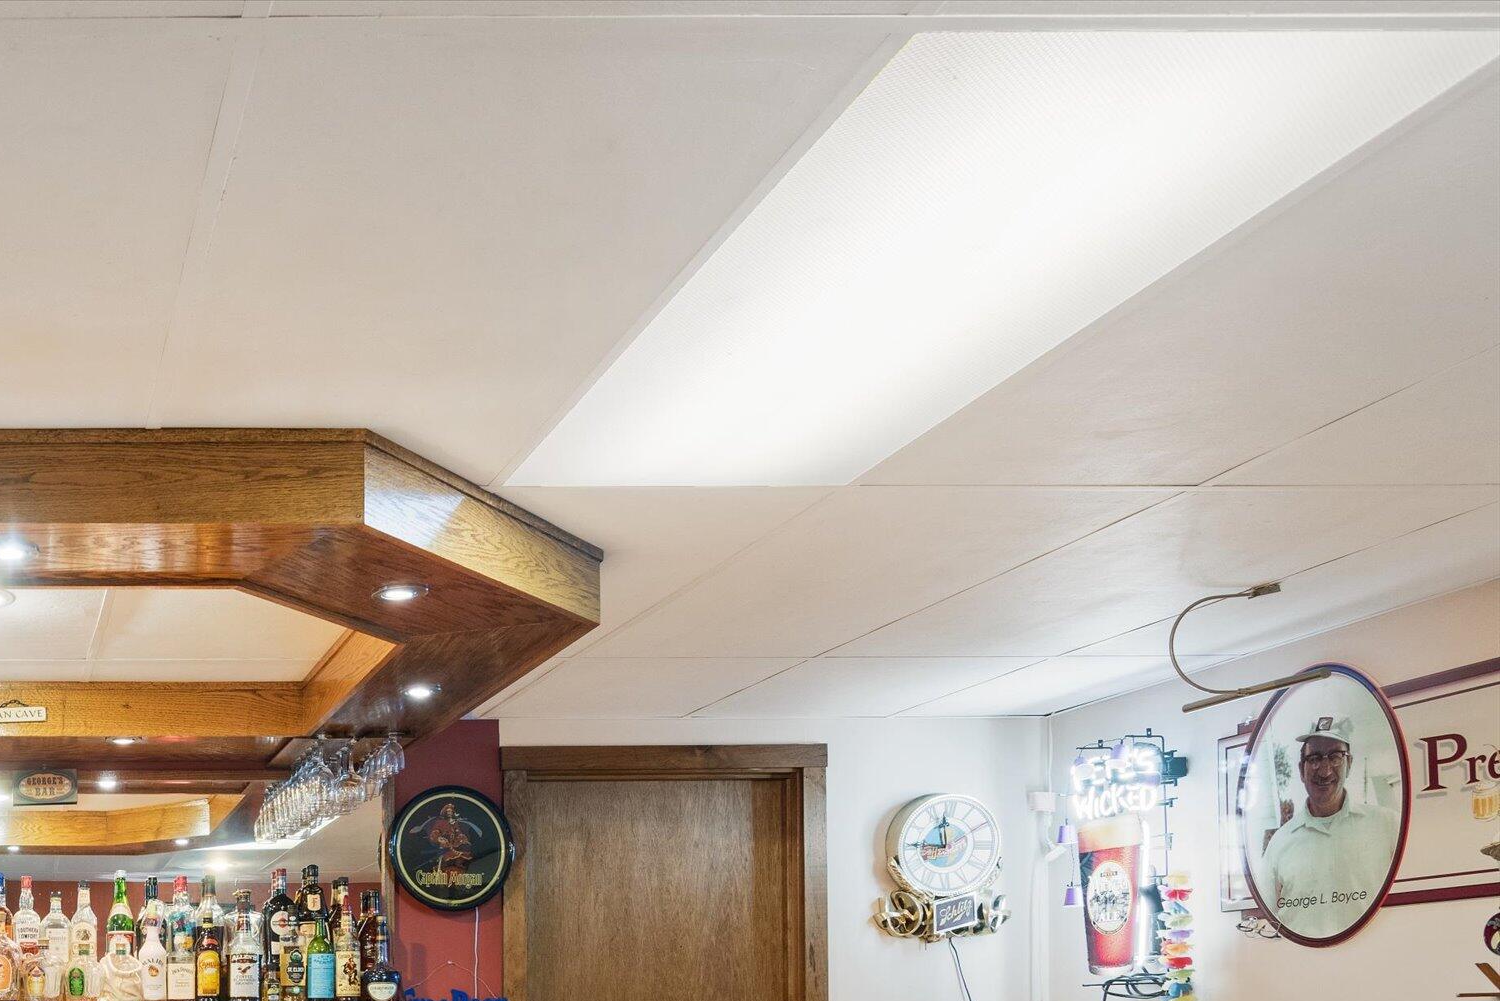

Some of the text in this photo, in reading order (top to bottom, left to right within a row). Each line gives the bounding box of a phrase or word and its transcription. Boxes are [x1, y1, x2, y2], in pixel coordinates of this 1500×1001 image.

[15, 710, 43, 718] CAVE
[26, 776, 64, 785] GEORGE'S
[35, 787, 55, 796] BAR
[1073, 785, 1157, 821] WICKED
[415, 869, 483, 888] Captain Morgan
[1276, 888, 1368, 910] George L. Boyce
